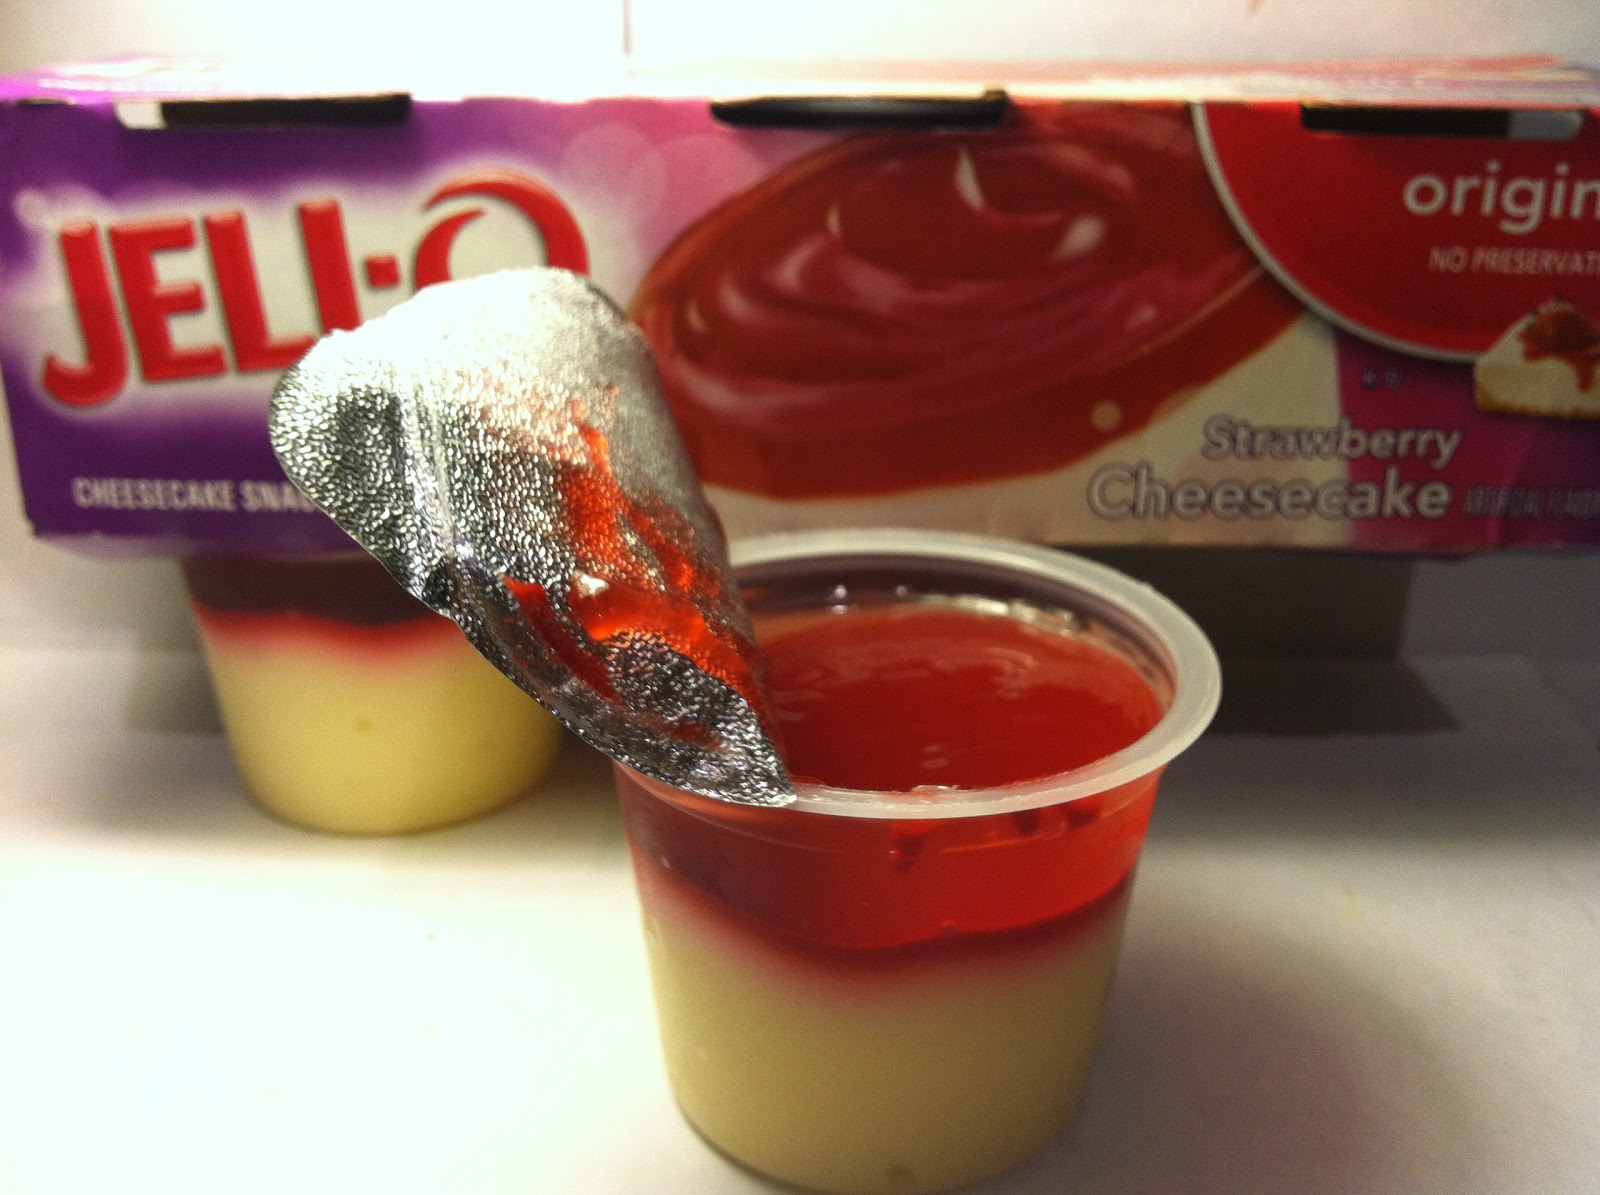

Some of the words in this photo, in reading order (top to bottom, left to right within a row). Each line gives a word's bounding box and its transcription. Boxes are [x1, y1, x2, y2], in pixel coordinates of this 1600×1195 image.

[1428, 247, 1468, 272] NO
[1472, 247, 1600, 275] PRESERVAT
[1203, 414, 1462, 468] Strawberry
[73, 477, 238, 511] CHEESECAKE
[1088, 462, 1452, 520] Cheesecake
